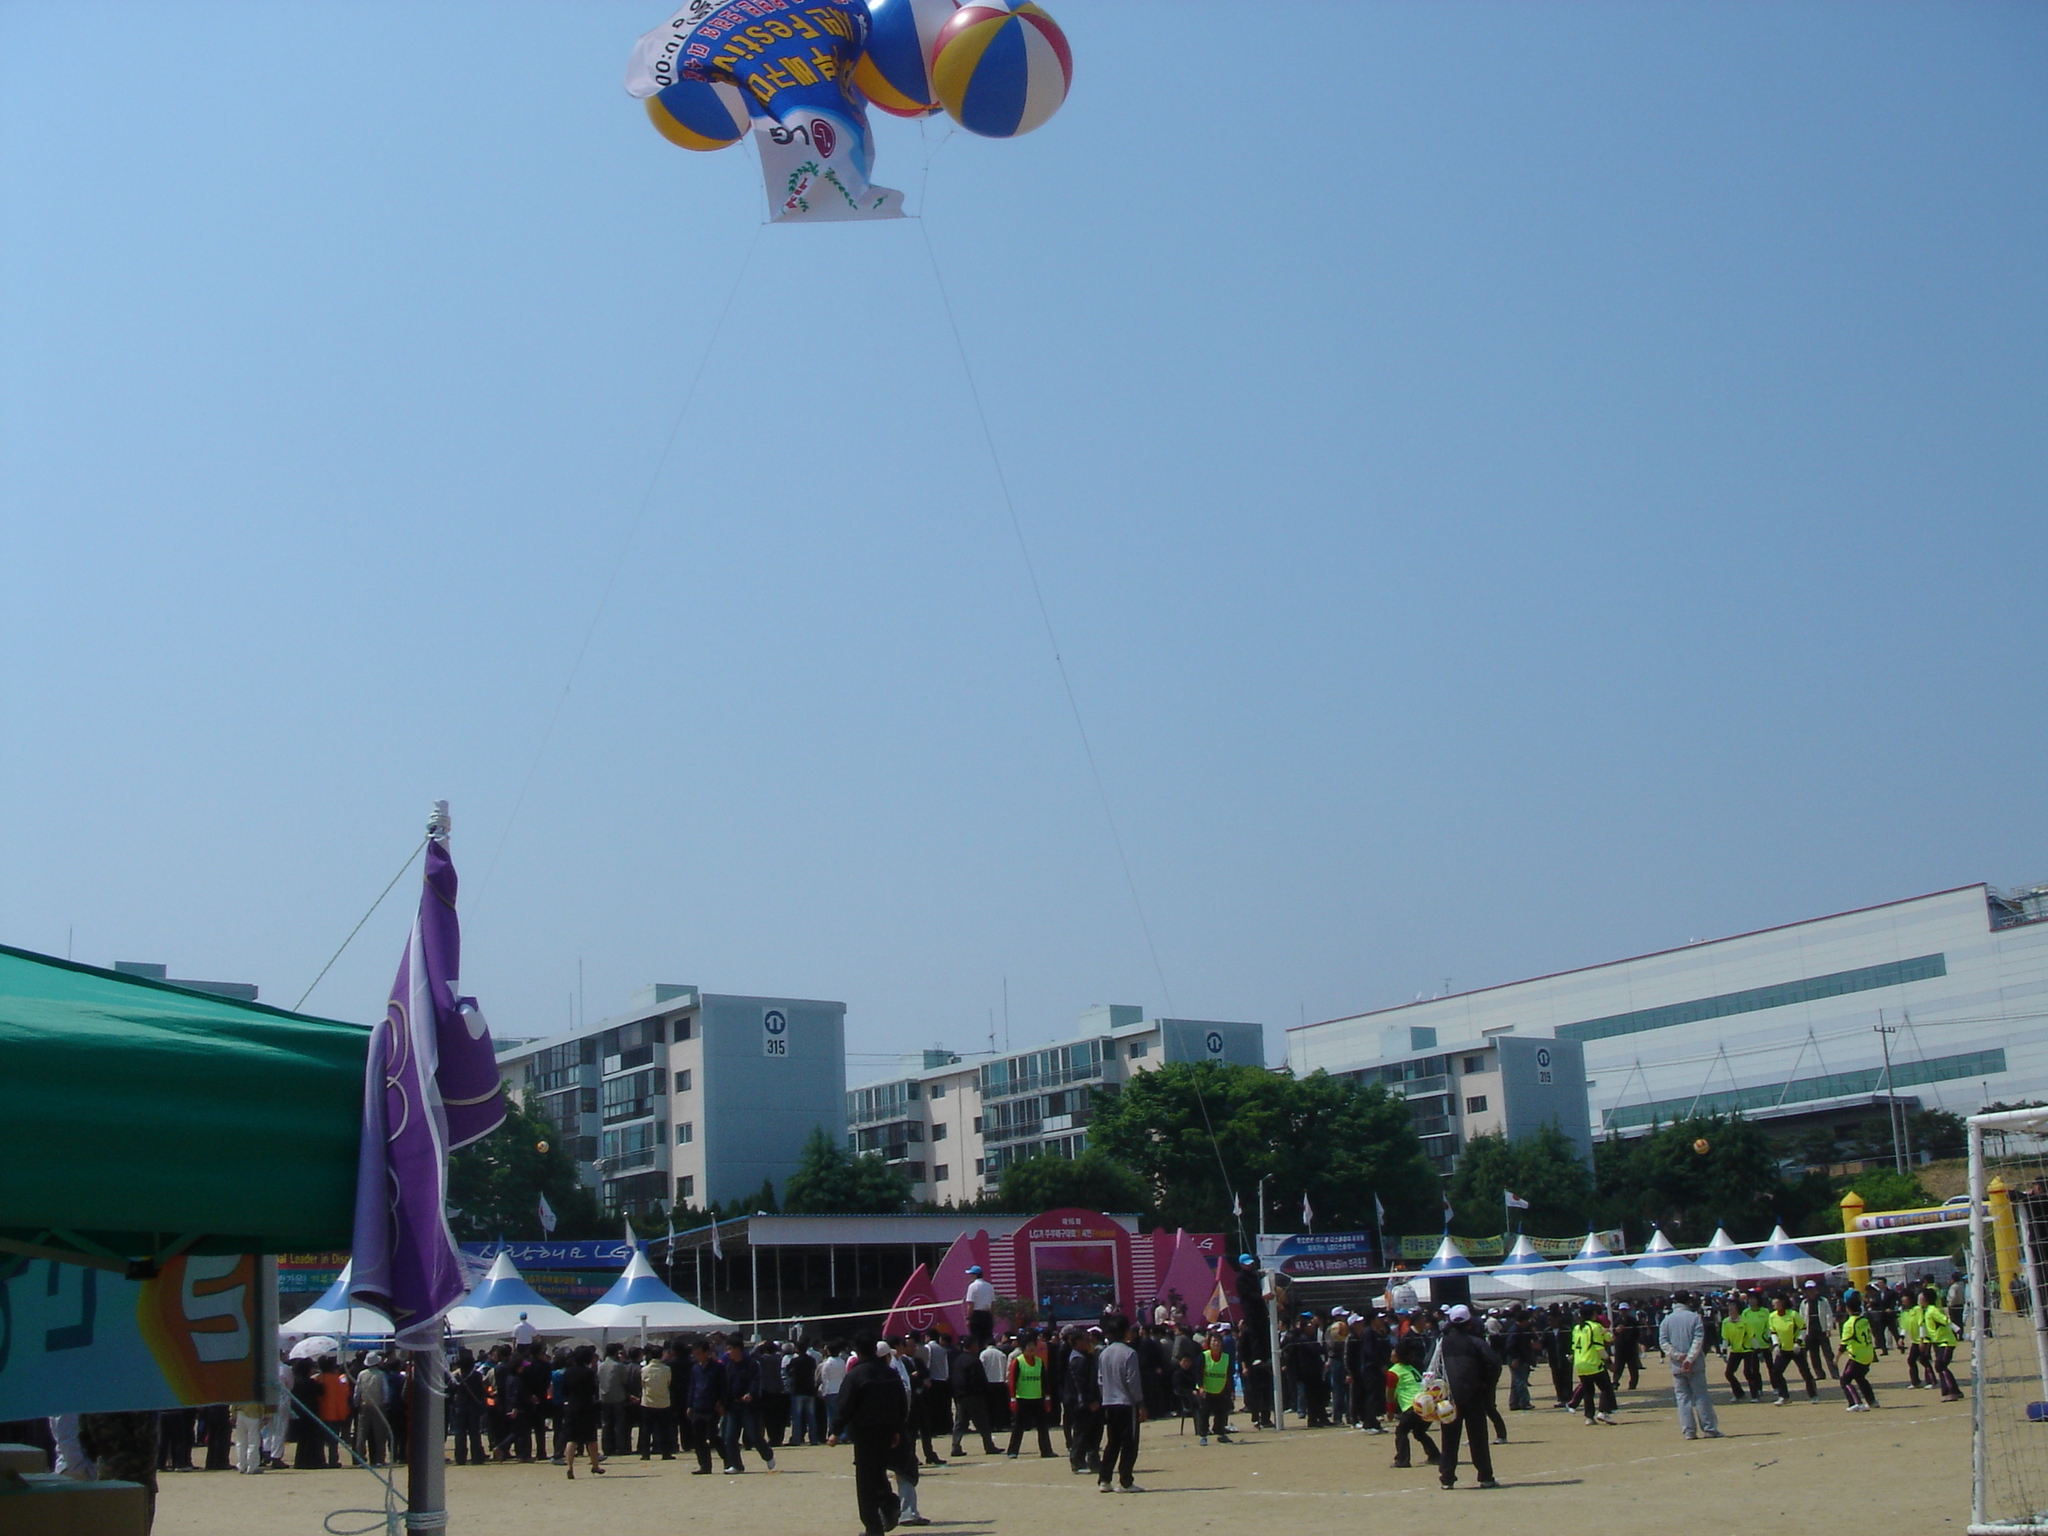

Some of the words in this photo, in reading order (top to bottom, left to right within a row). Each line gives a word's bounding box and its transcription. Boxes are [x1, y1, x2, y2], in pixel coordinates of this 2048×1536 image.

[767, 1039, 785, 1055] 315
[1196, 1237, 1214, 1251] G
[290, 1253, 318, 1264] Leader
[321, 1253, 329, 1264] in
